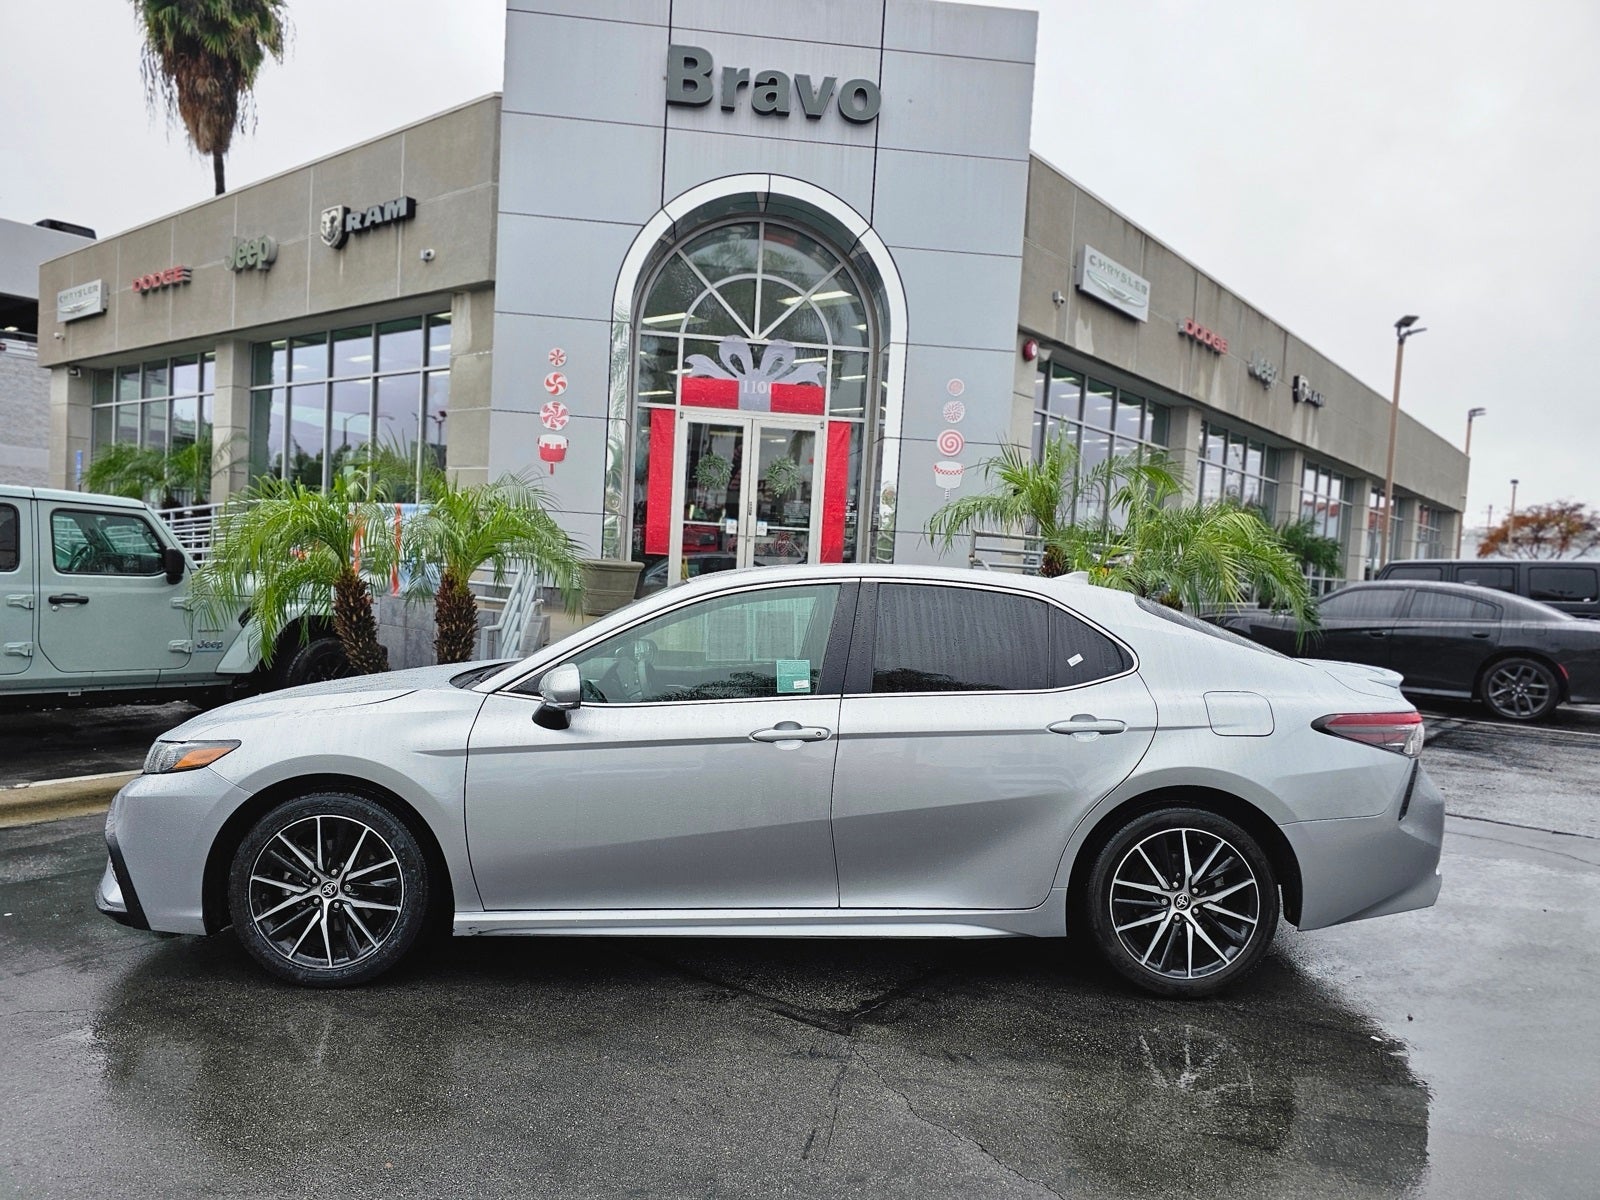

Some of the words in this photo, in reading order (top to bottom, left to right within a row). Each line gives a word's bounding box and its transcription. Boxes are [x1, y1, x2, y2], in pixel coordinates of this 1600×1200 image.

[666, 44, 881, 123] Bravo
[345, 196, 411, 233] RAM
[224, 234, 273, 273] Jeep
[132, 266, 186, 293] DODGE
[1088, 253, 1148, 295] CHRYSLER
[58, 284, 99, 304] CHRYSLER
[1183, 316, 1229, 354] DODGE
[197, 639, 224, 650] Jeep
